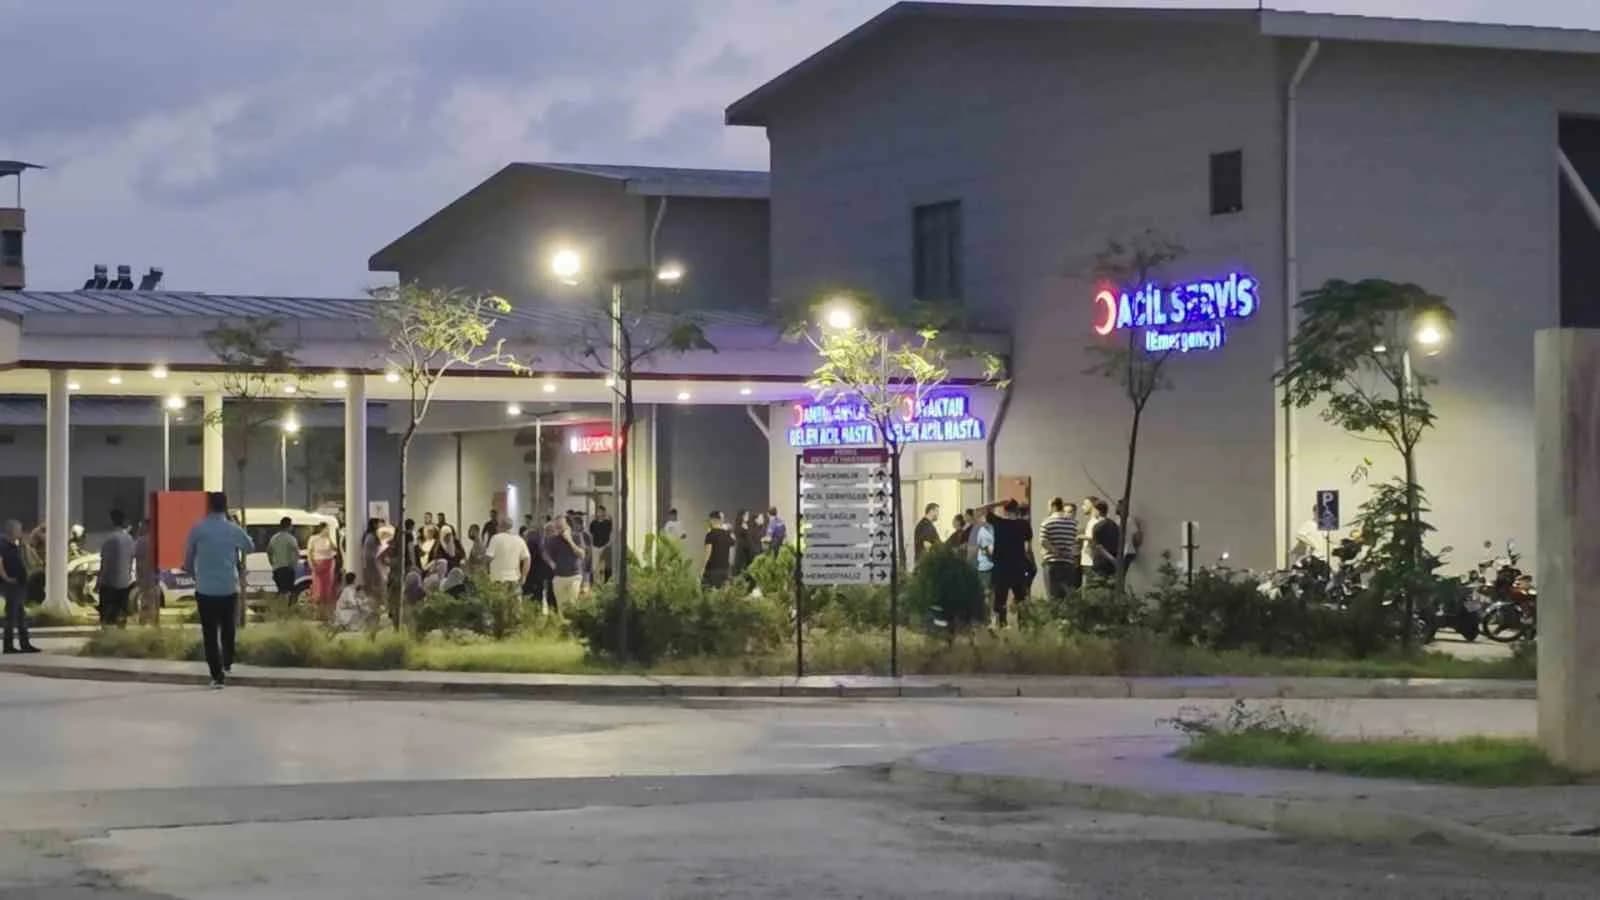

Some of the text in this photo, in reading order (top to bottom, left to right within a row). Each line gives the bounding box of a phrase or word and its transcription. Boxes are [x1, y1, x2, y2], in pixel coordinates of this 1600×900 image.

[1116, 282, 1167, 329] ACİL
[945, 417, 982, 438] HASTA
[1323, 492, 1333, 506] P
